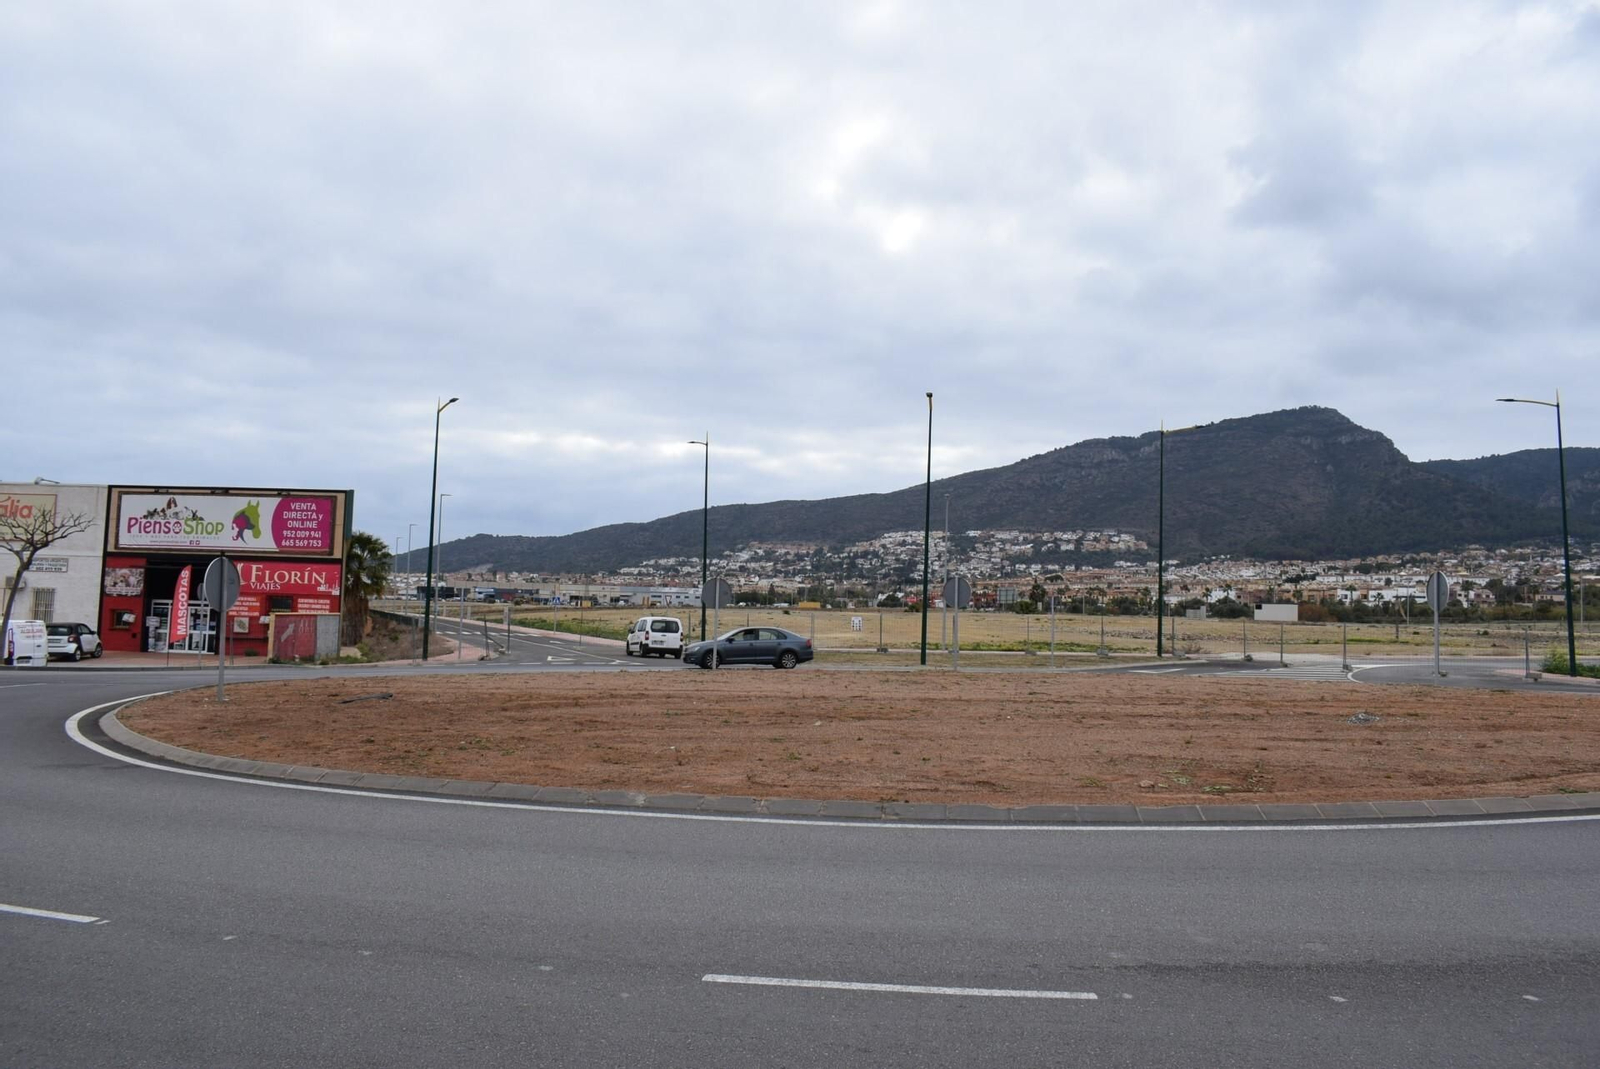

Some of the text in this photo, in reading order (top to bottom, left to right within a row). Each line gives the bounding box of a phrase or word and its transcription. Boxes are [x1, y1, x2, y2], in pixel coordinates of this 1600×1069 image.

[290, 502, 317, 510] VENTA
[283, 511, 324, 521] DIRECTA y
[287, 520, 318, 529] ONLINE
[283, 530, 295, 538] 952
[296, 530, 309, 538] 009
[295, 539, 308, 547] 569
[250, 564, 326, 585] FLORÍN
[250, 582, 281, 591] VIAJES
[177, 569, 189, 635] MASCOTAS
